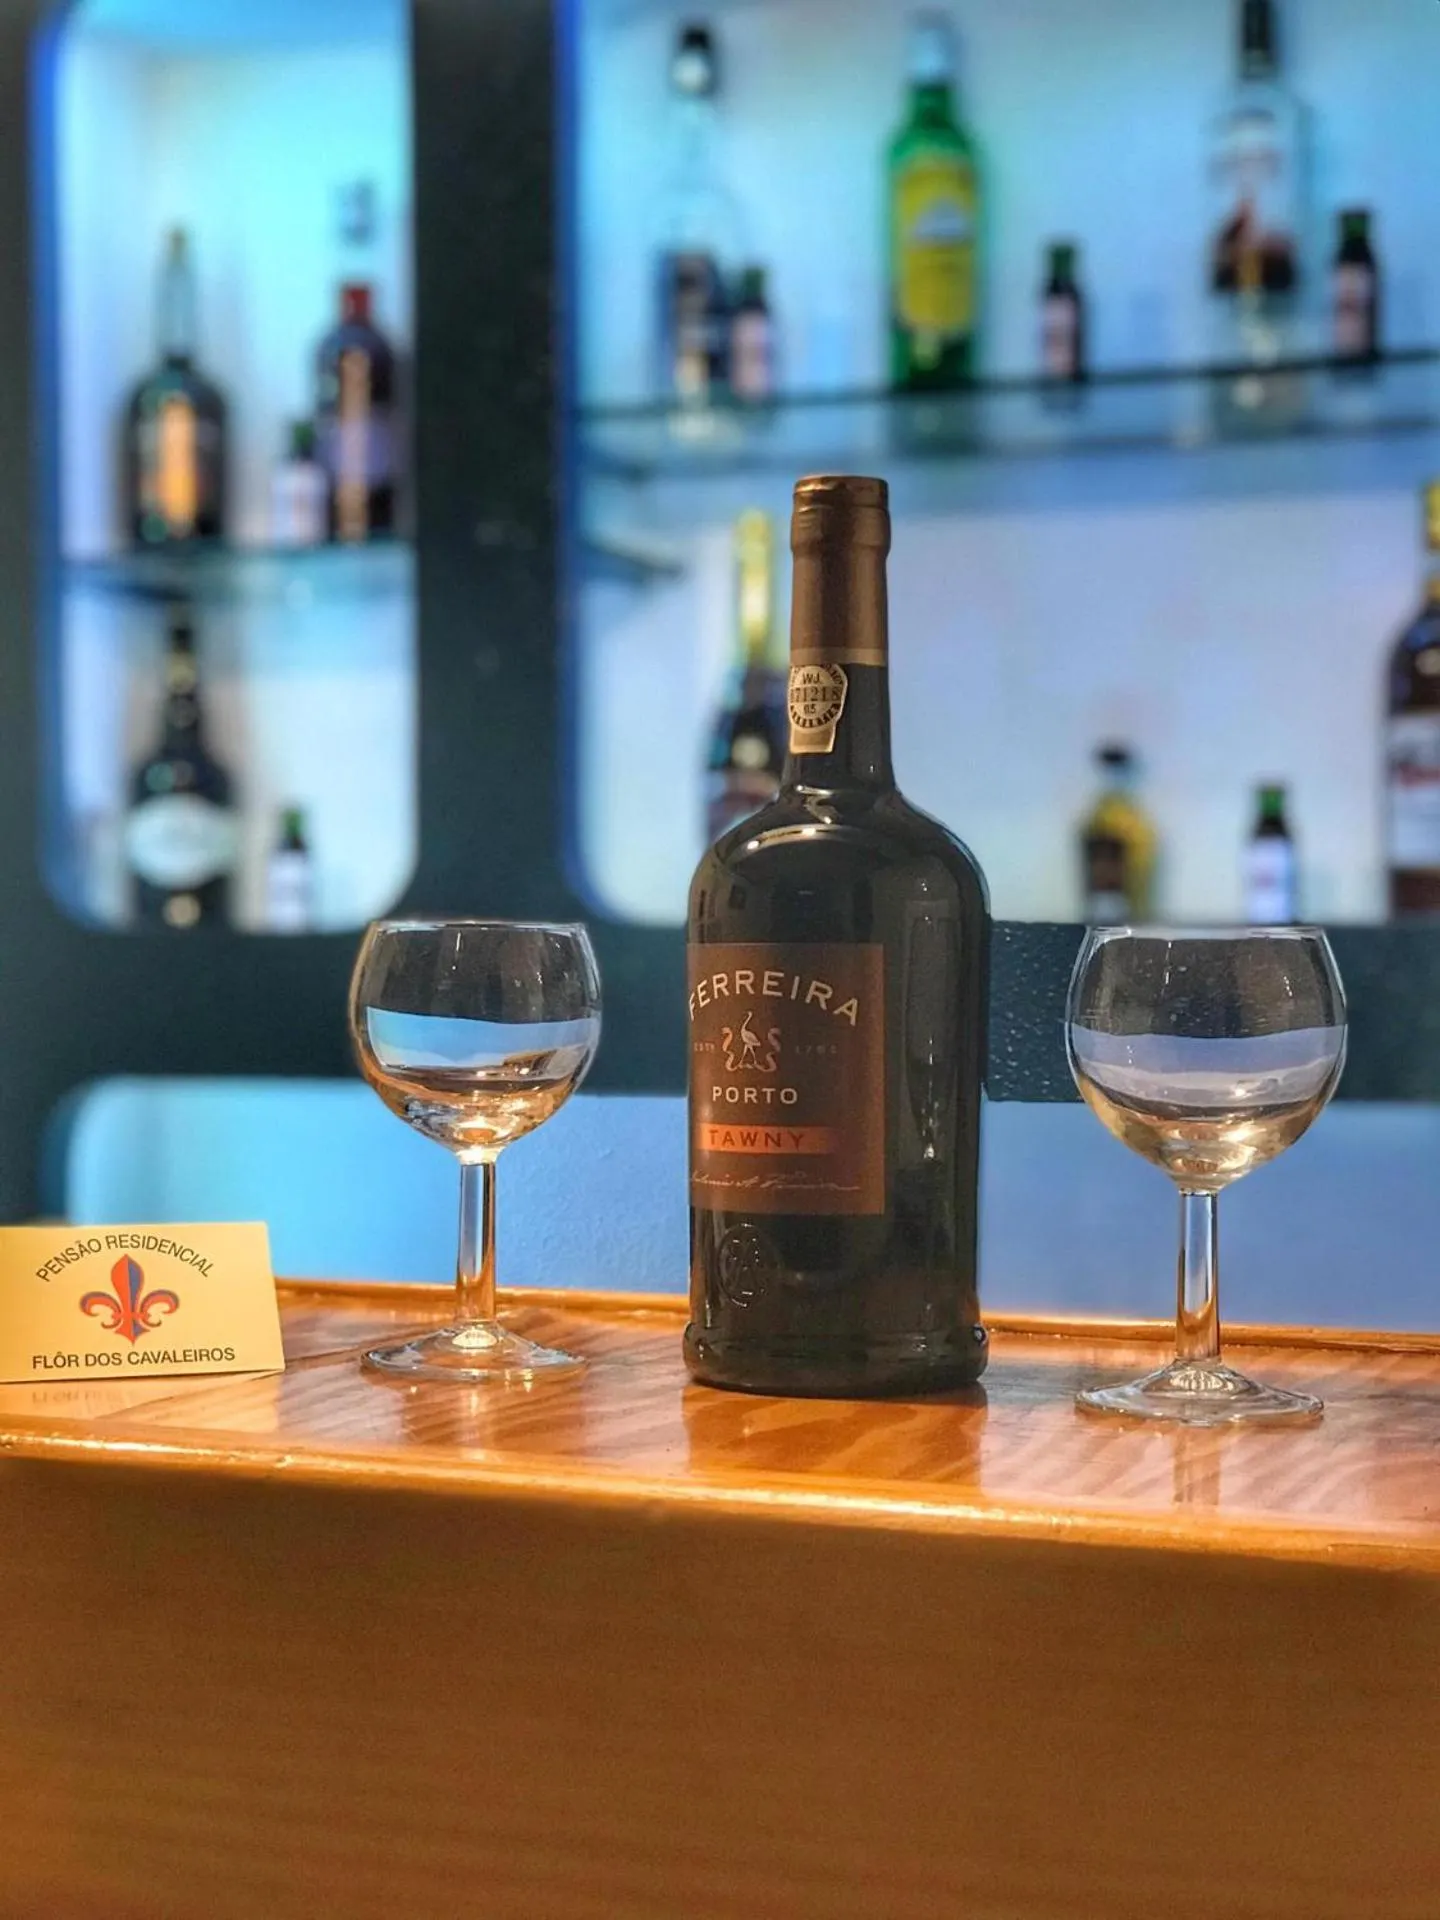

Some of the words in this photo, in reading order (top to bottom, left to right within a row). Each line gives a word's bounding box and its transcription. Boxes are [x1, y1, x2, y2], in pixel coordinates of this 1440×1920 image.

[689, 970, 858, 1026] FERREIRA
[712, 1086, 798, 1105] PORTO
[708, 1129, 805, 1150] TAWNY
[36, 1238, 102, 1283] PENSÃO
[105, 1234, 216, 1278] RESIDENCIAL
[32, 1351, 79, 1369] FLÔR
[85, 1352, 122, 1366] DOS
[127, 1347, 235, 1365] CAVALEIROS
